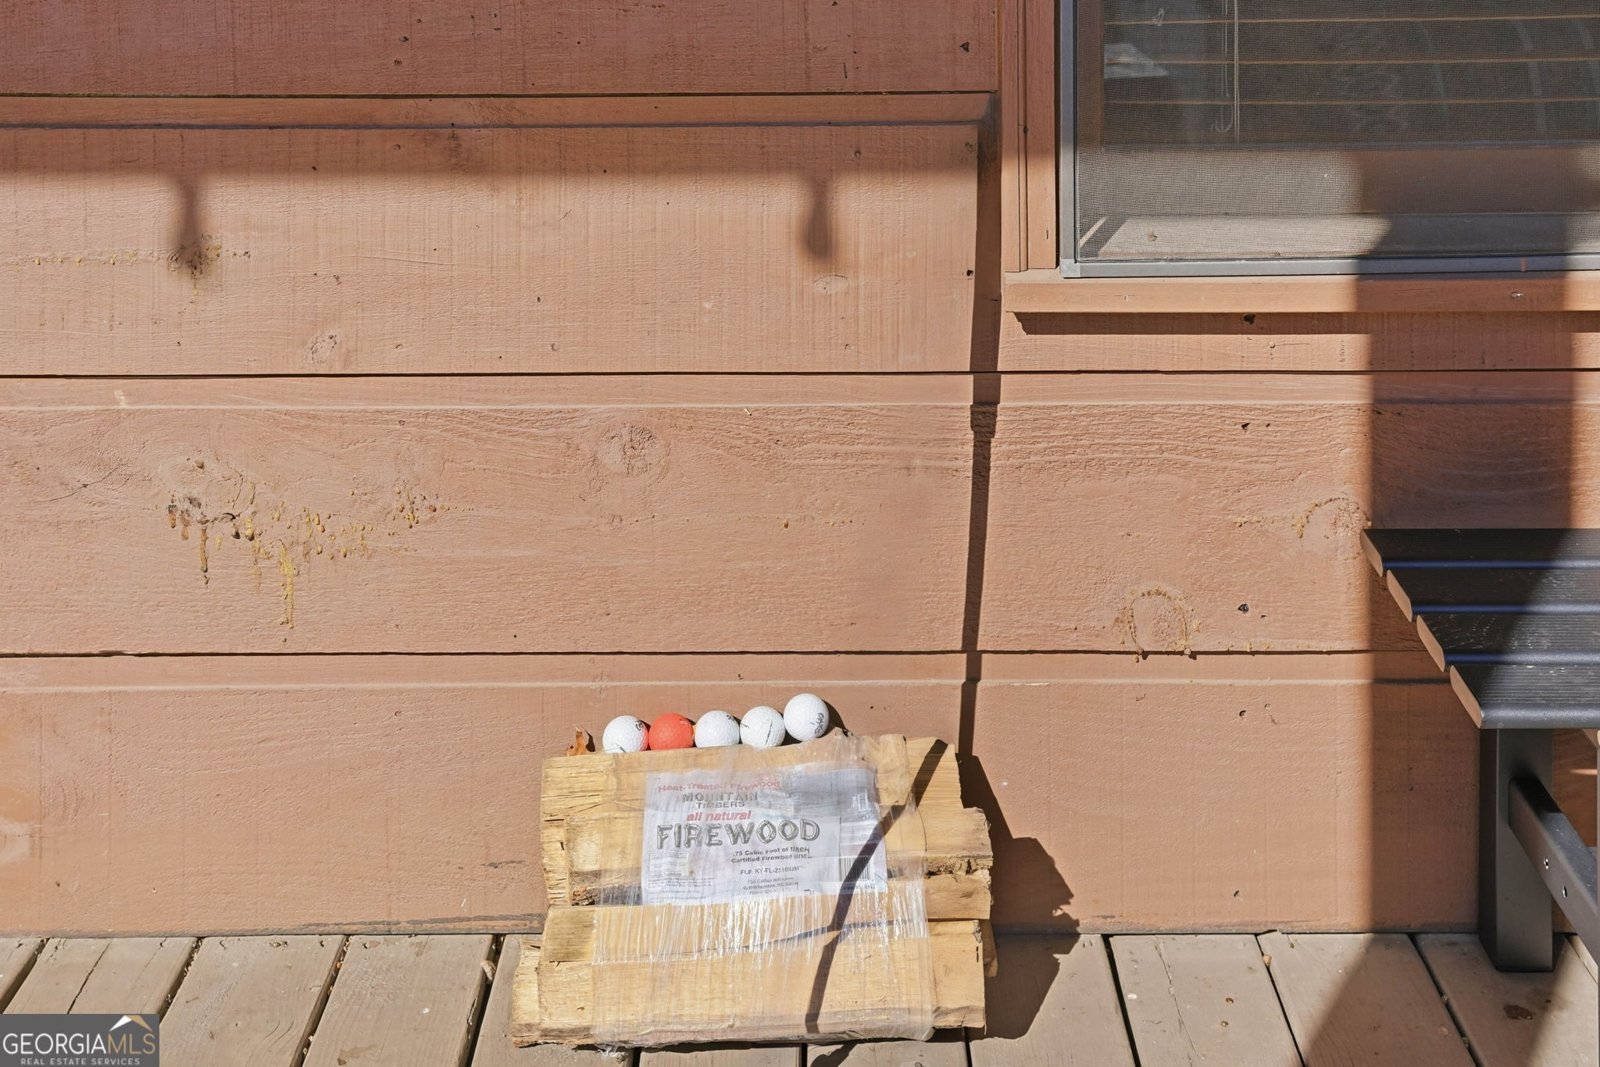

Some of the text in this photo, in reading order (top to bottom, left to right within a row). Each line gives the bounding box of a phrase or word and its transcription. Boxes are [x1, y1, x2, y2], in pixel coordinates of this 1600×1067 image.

[682, 792, 758, 802] MOUNTAIN
[696, 801, 746, 809] TIMBERS
[687, 810, 752, 821] all natural
[657, 818, 820, 850] FIREWOOD
[731, 855, 760, 863] Certified
